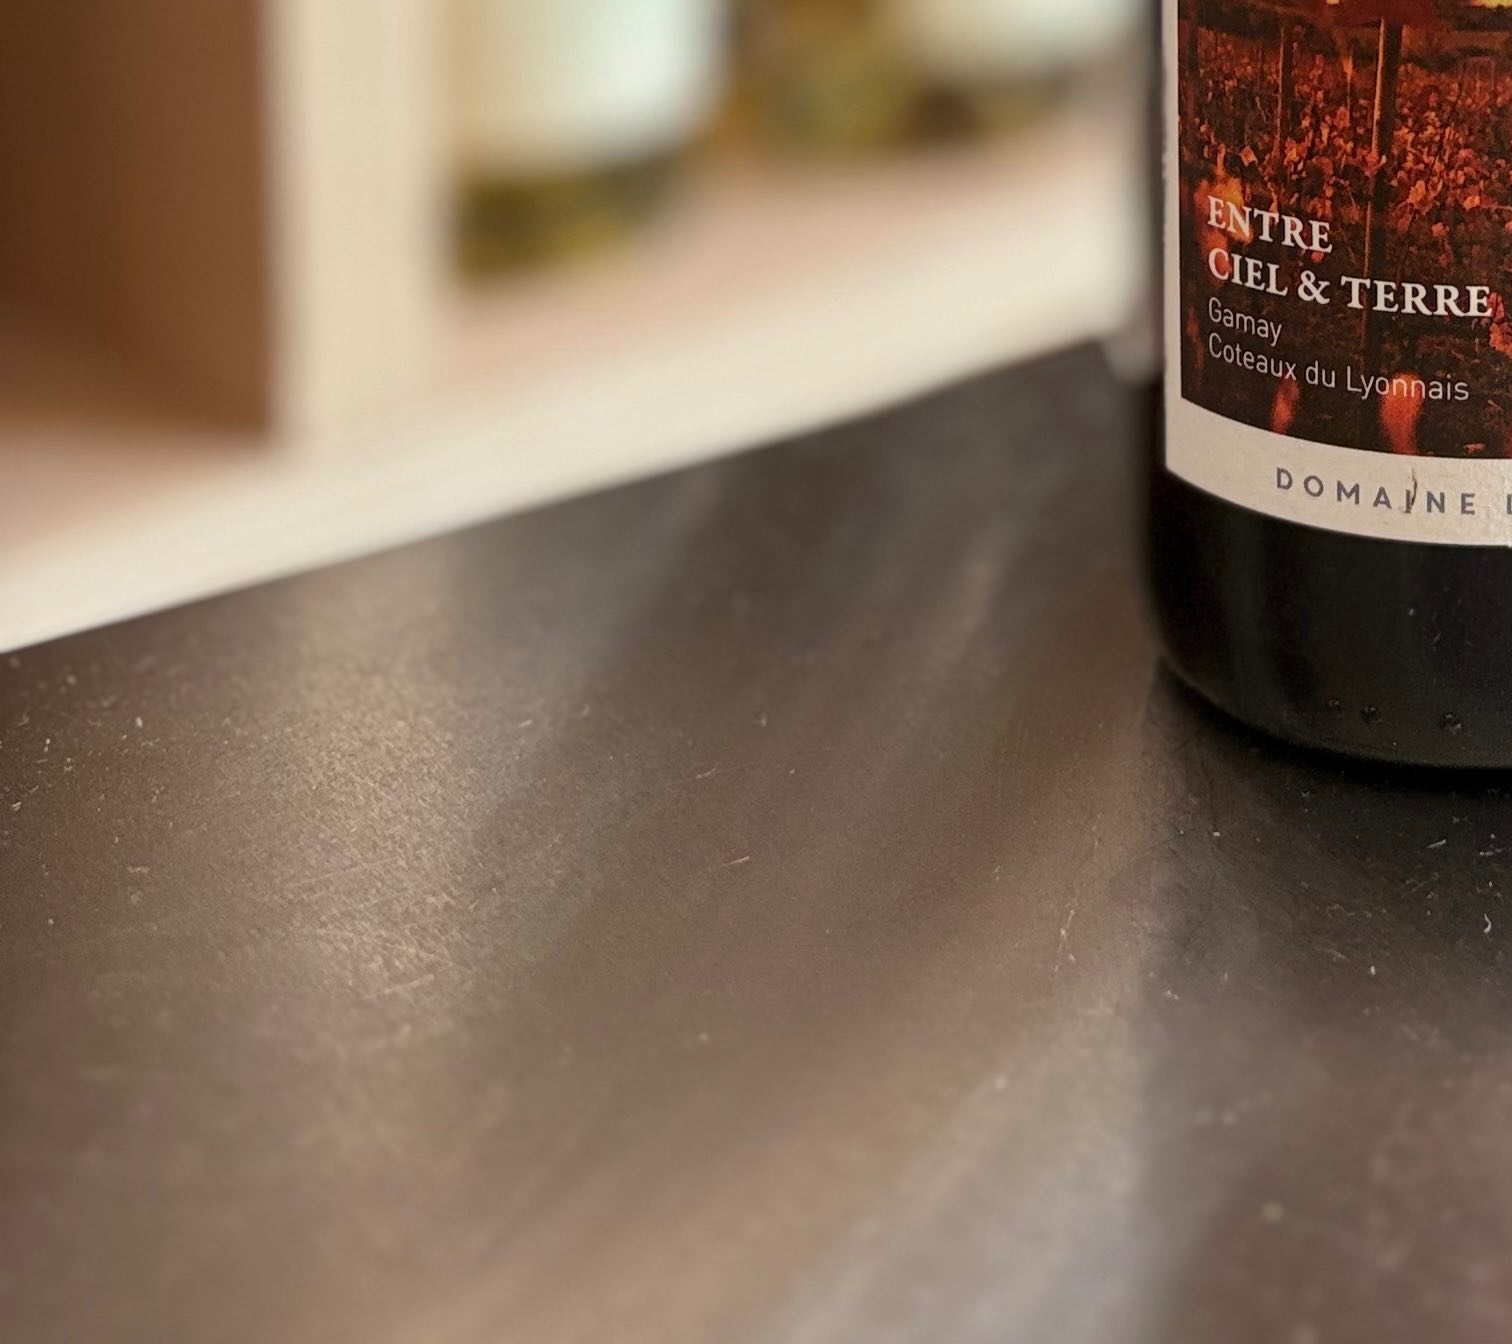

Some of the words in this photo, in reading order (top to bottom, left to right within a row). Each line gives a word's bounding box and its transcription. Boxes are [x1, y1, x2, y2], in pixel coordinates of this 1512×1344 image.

[1207, 195, 1333, 253] ENTRE
[1208, 247, 1288, 297] CIEL
[1298, 269, 1330, 305] &
[1340, 275, 1493, 317] TERRE
[1208, 297, 1282, 346] Gamay
[1208, 332, 1297, 381] Coteaux
[1305, 360, 1336, 388] du
[1346, 365, 1469, 401] Lyonnais
[1275, 466, 1477, 515] DOMAINE
